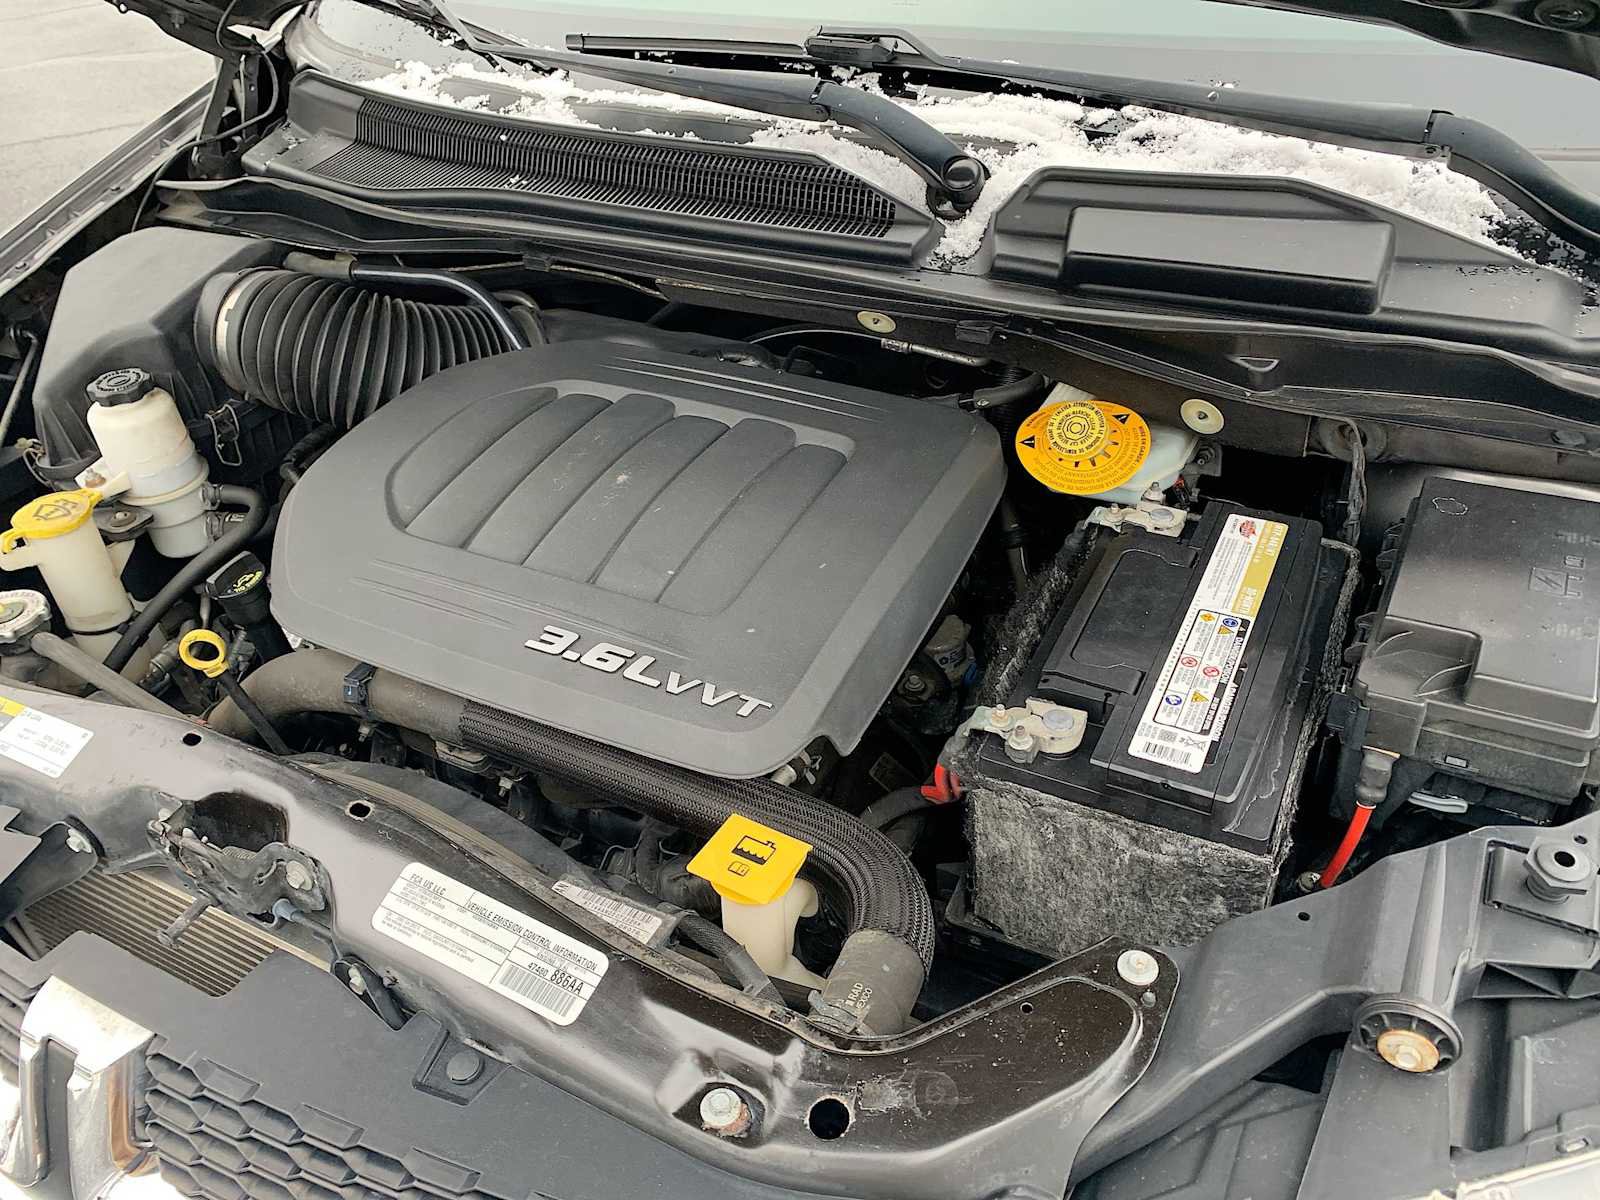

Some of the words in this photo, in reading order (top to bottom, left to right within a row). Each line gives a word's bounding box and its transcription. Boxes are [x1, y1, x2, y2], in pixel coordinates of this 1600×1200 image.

[409, 873, 423, 885] FCA
[423, 879, 434, 890] US
[433, 884, 446, 896] LLC
[467, 900, 493, 919] VEHICLE
[492, 914, 523, 934] EMISSION
[522, 928, 552, 949] CONTROL
[552, 943, 598, 972] INFORMATION
[550, 969, 584, 995] 886AA
[847, 982, 863, 1001] RAD
